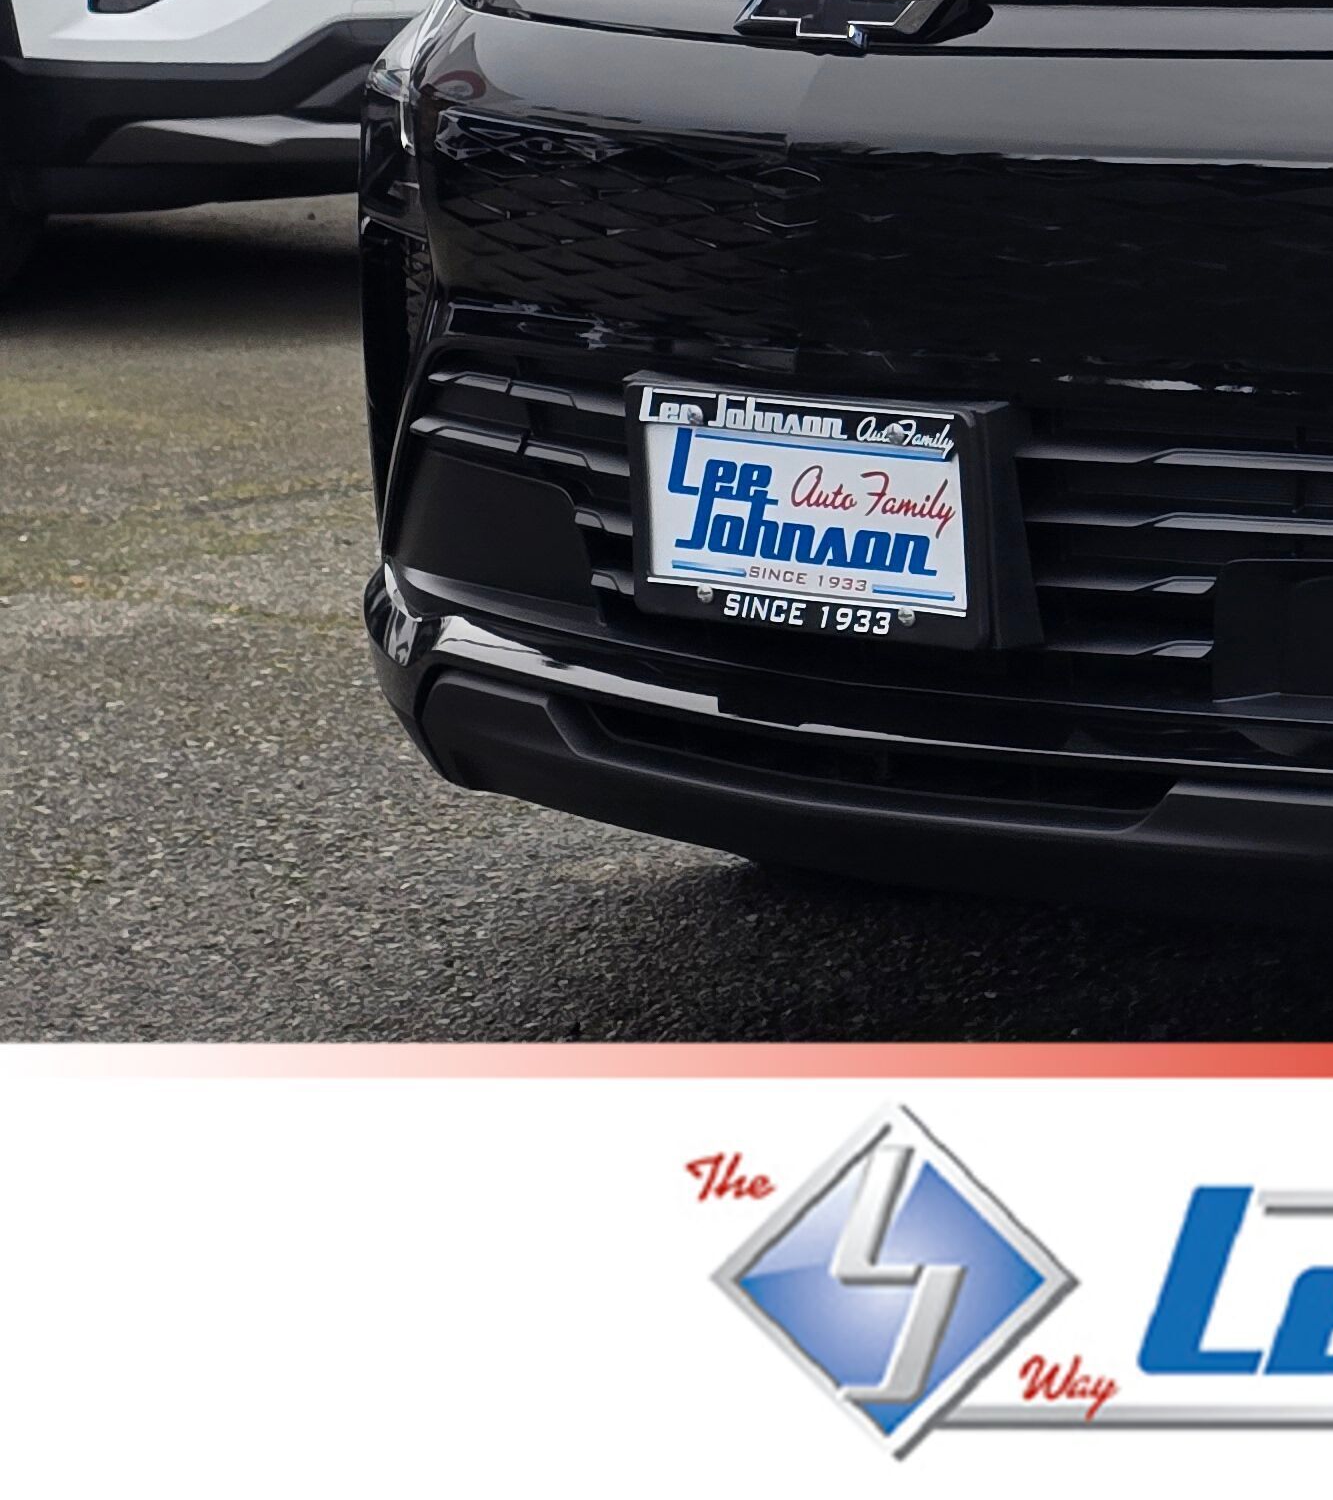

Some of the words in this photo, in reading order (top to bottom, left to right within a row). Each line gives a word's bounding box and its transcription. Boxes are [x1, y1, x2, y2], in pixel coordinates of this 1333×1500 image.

[707, 393, 848, 440] Johnson
[856, 415, 904, 444] Aut
[898, 419, 955, 460] Family
[667, 427, 778, 506] Lee
[674, 490, 937, 576] Johnson
[790, 465, 858, 511] Auto
[860, 471, 956, 539] Family
[723, 593, 807, 626] SINCE
[820, 605, 892, 635] 1933
[749, 566, 808, 585] SINCE
[818, 575, 868, 592] 1933
